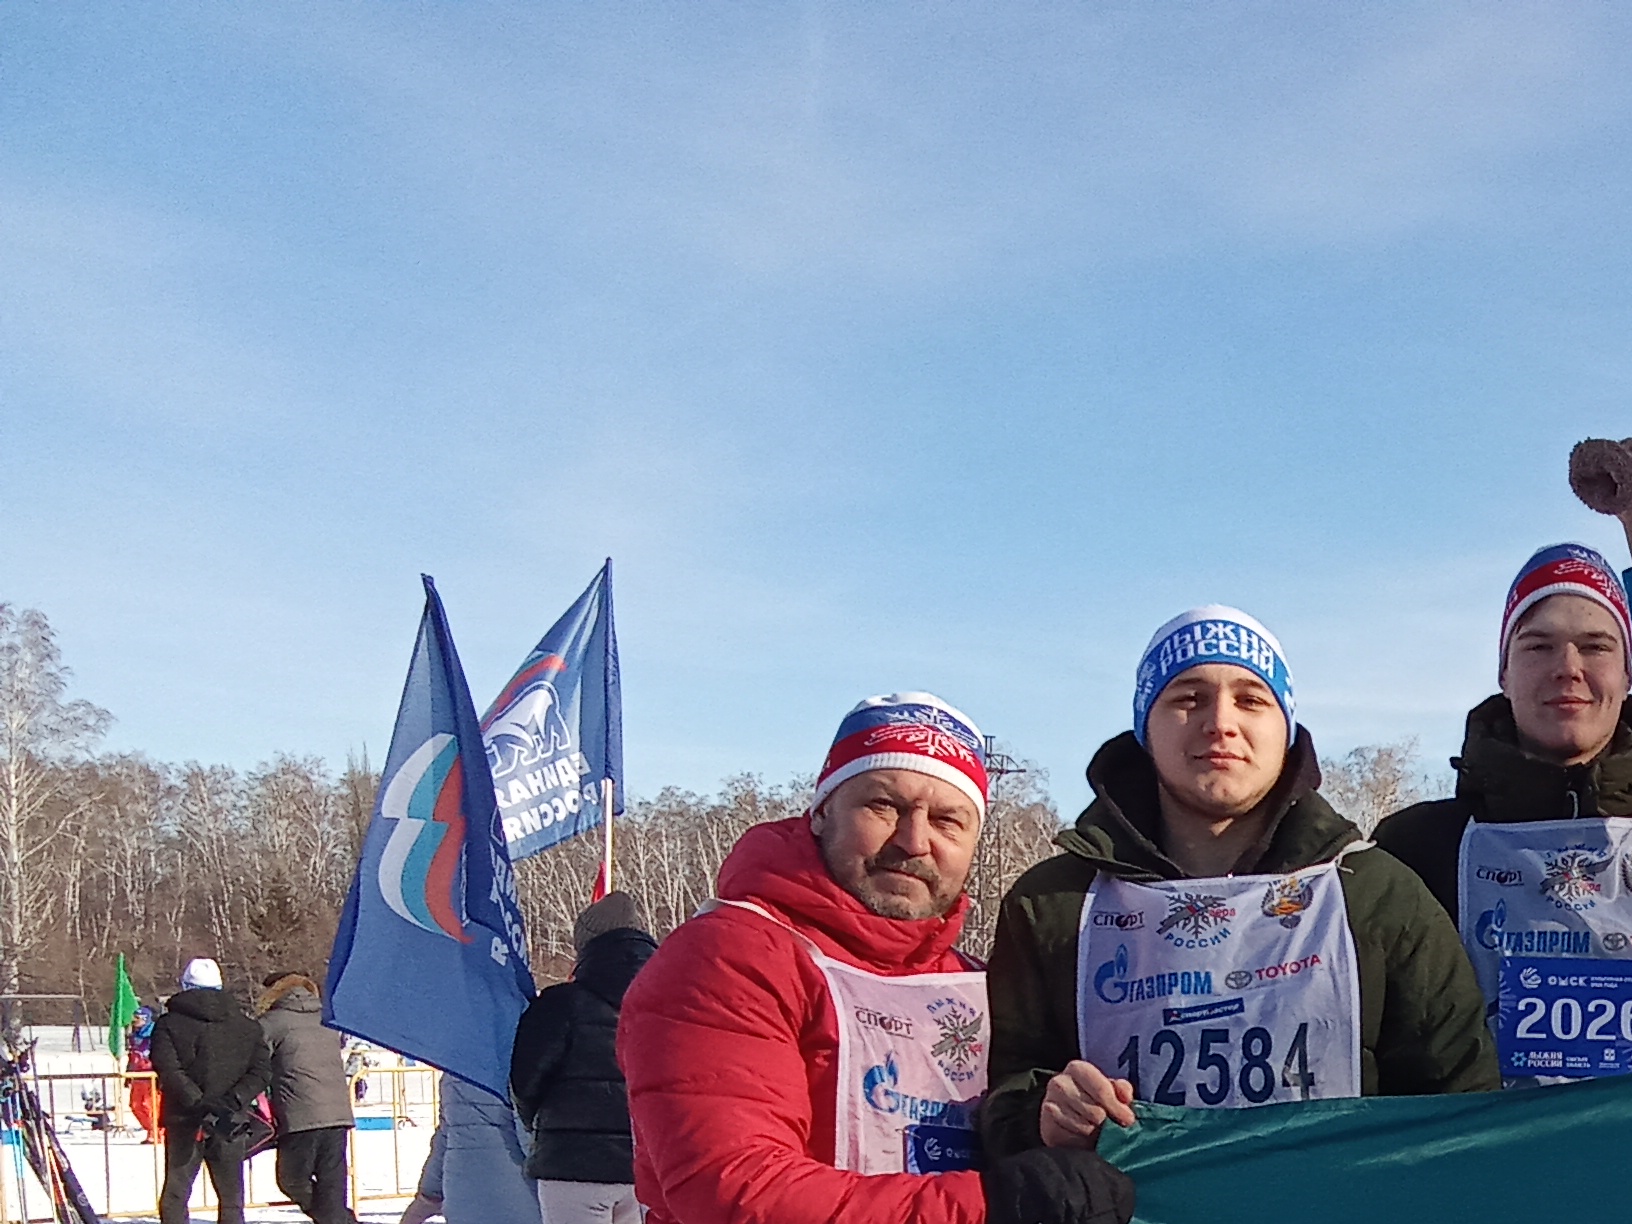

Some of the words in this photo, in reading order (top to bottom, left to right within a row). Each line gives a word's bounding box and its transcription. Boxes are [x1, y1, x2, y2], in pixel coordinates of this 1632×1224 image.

[1159, 622, 1274, 661] ЛЫЖНЯ
[1160, 639, 1275, 678] РОССИИ
[1093, 911, 1145, 930] СПОРТ
[1164, 926, 1232, 949] РОССИИ
[1506, 931, 1591, 954] ГАЗПРОМ
[1254, 953, 1323, 981] TOYOTA
[1128, 970, 1213, 1003] ГАЗПРОМ
[1547, 976, 1588, 987] ОМСК
[854, 1006, 914, 1039] СПОРТ
[1117, 1022, 1315, 1107] 12584
[1527, 1060, 1563, 1068] РОССИИ
